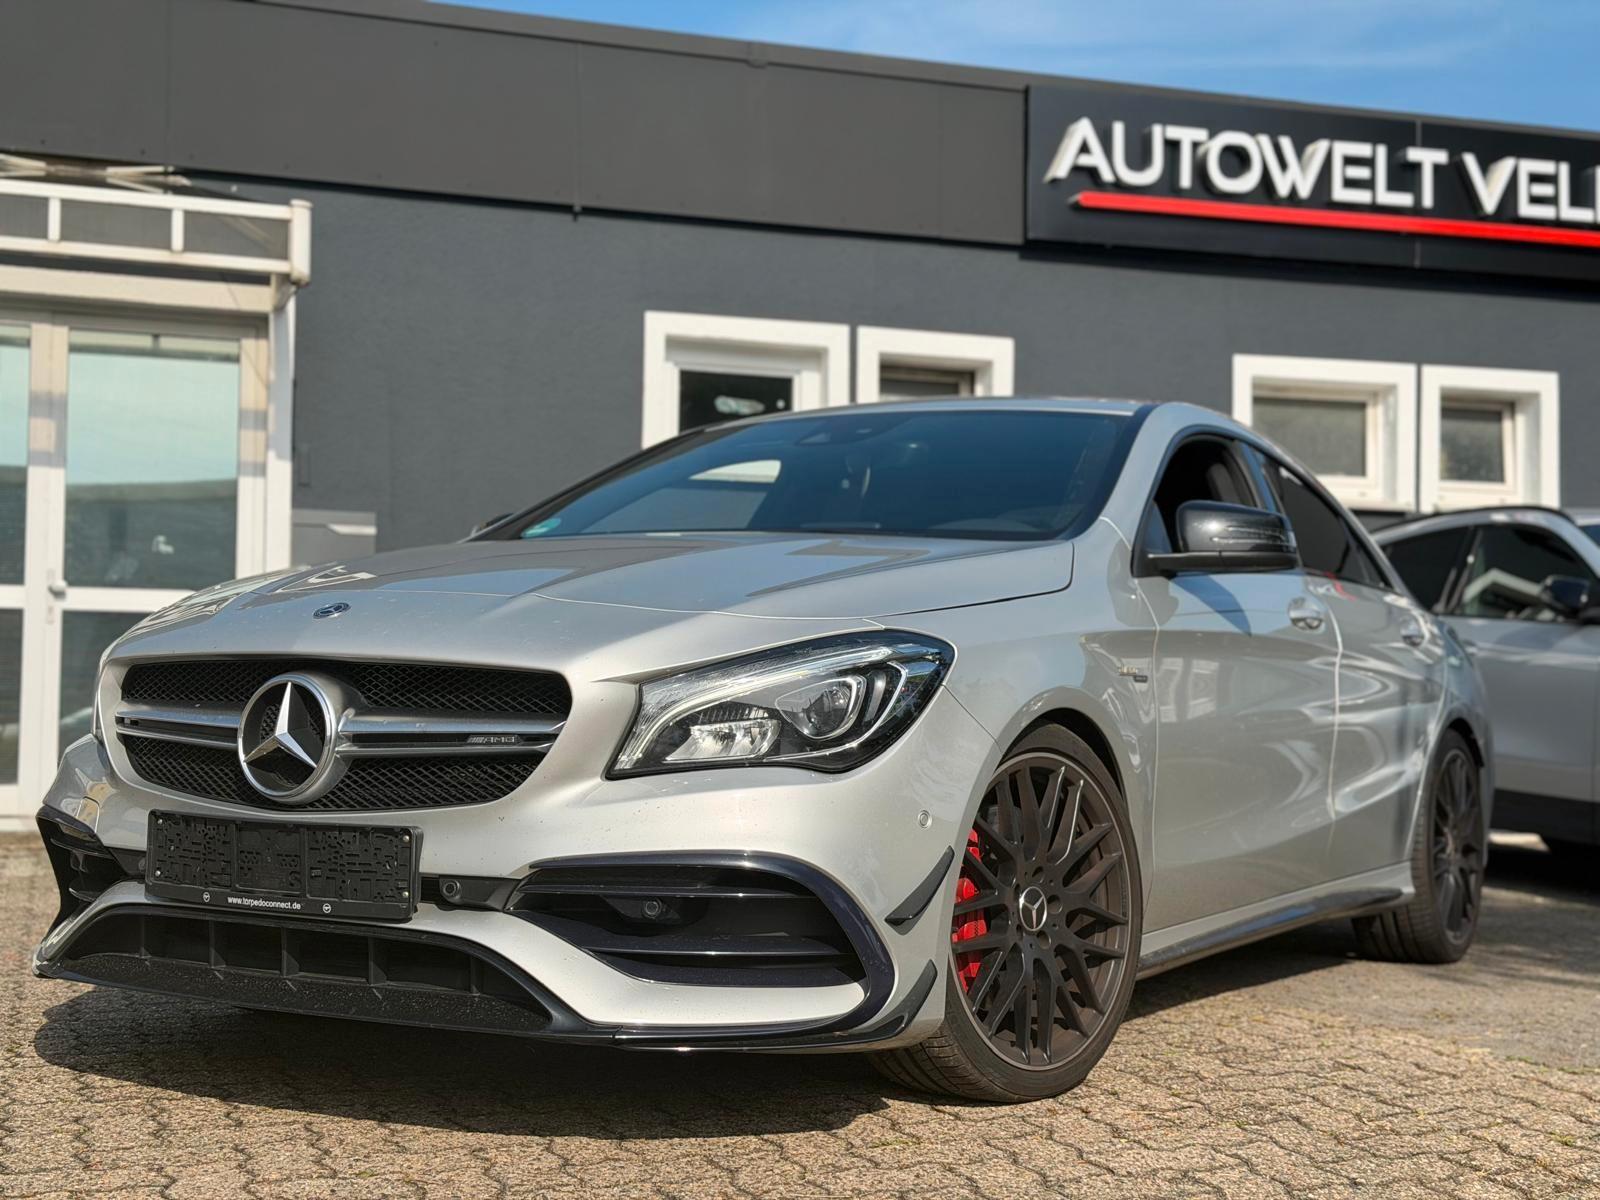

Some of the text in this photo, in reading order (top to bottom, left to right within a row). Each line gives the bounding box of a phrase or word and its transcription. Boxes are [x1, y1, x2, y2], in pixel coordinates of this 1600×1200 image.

[1046, 116, 1600, 225] AUTOWELT VEL
[227, 896, 302, 910] www.torpedoconnect.de
